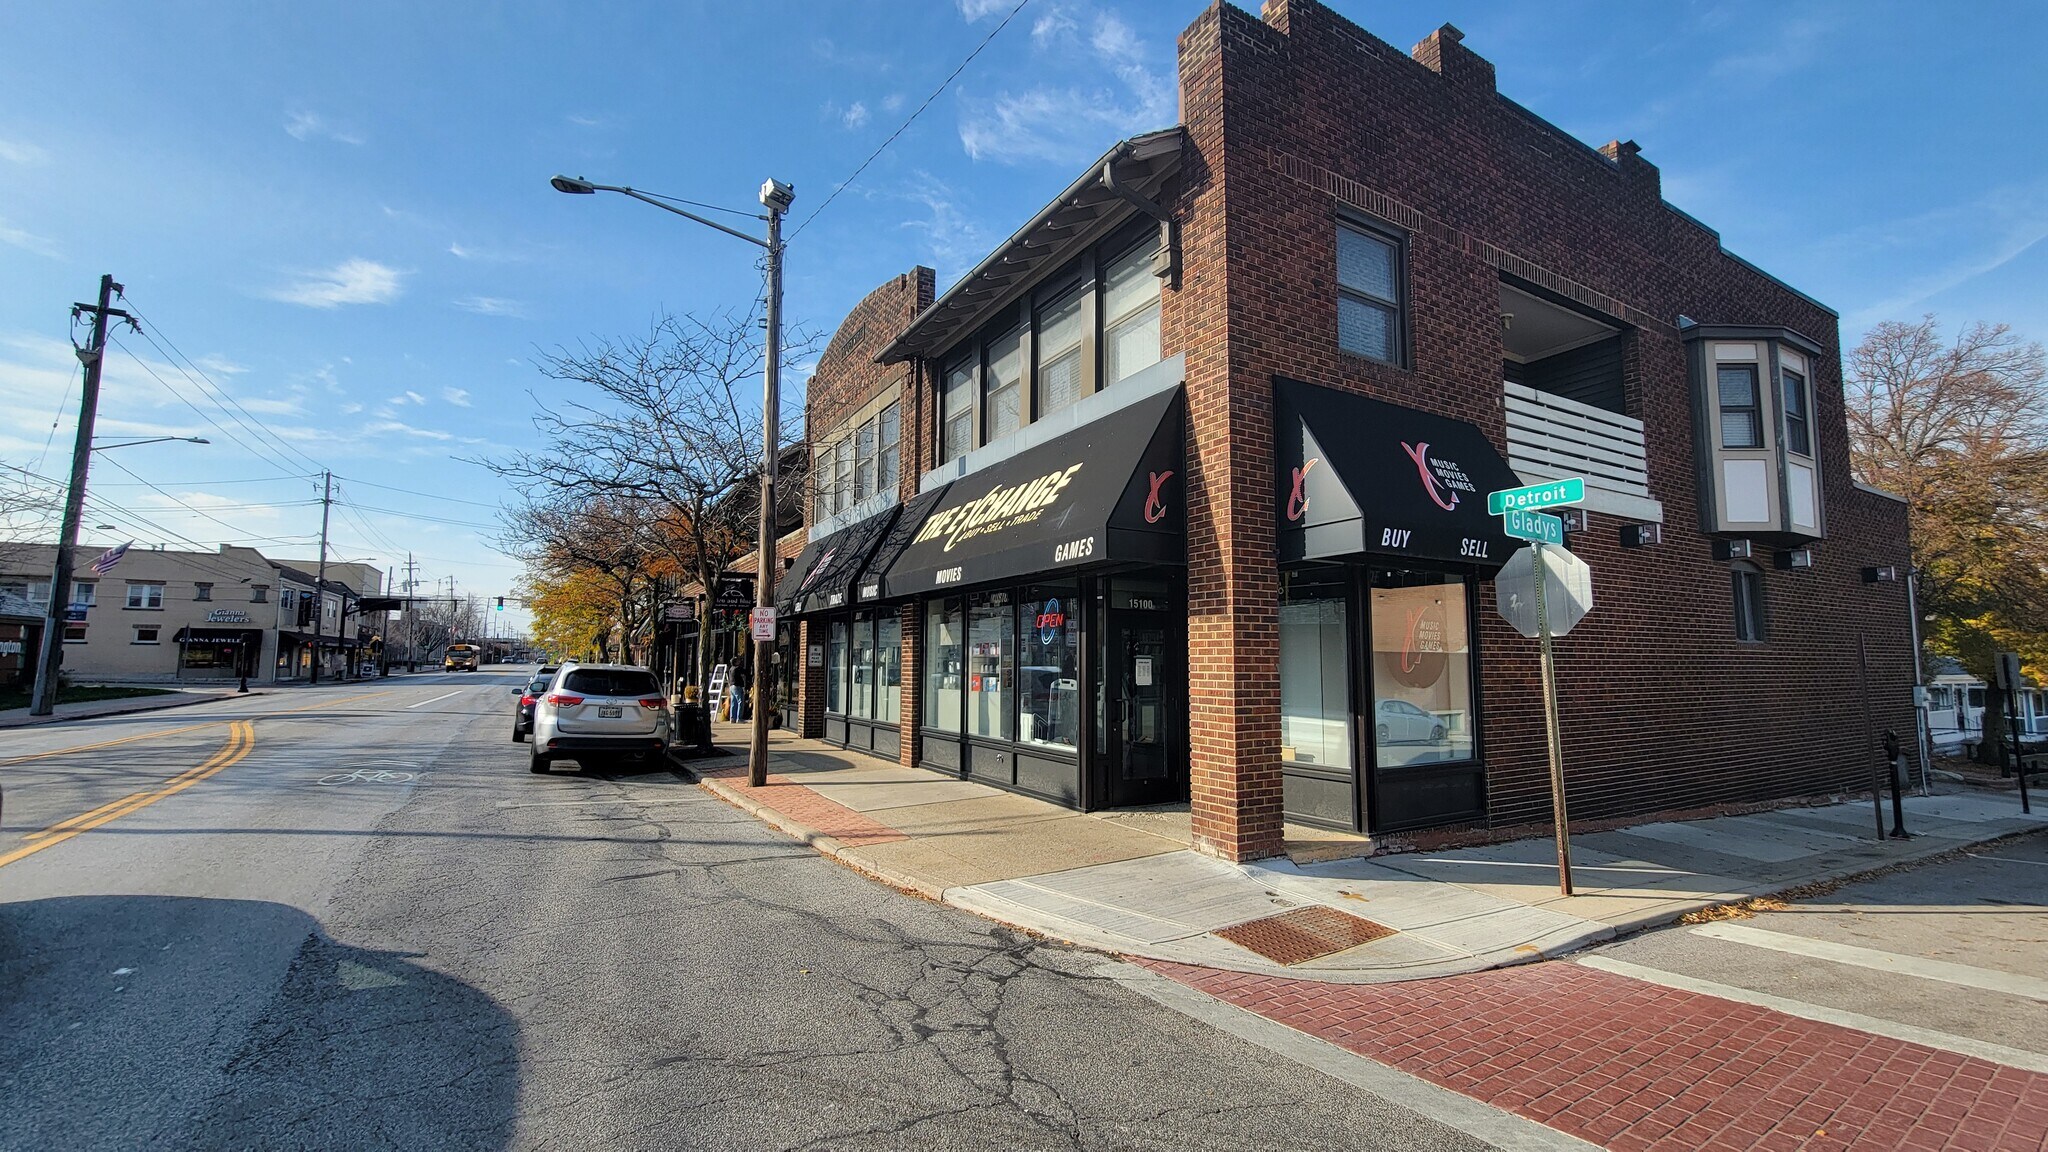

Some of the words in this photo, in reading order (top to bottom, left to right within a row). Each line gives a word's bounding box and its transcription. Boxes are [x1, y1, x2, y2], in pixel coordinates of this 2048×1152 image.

[1430, 458, 1459, 471] MUSIC
[1435, 468, 1470, 482] MOVIES
[1444, 478, 1476, 493] GAMES
[1505, 484, 1567, 507] Detroit
[912, 506, 961, 545] THE
[944, 462, 1083, 552] EXCHANGE
[984, 520, 1004, 534] SELL
[1010, 509, 1044, 527] TRADE
[1512, 509, 1557, 540] Gladys
[1381, 528, 1411, 548] BUY
[1460, 538, 1488, 558] SELL
[935, 566, 962, 585] MOVIES
[1054, 536, 1094, 563] GAMES
[1129, 598, 1153, 609] 15100
[205, 612, 251, 623] Jewelers
[214, 608, 246, 616] Gianna
[1036, 613, 1065, 629] OPEN
[1420, 620, 1440, 630] MUSIC
[1419, 630, 1441, 640] MOVIES
[1420, 640, 1441, 650] GAMES
